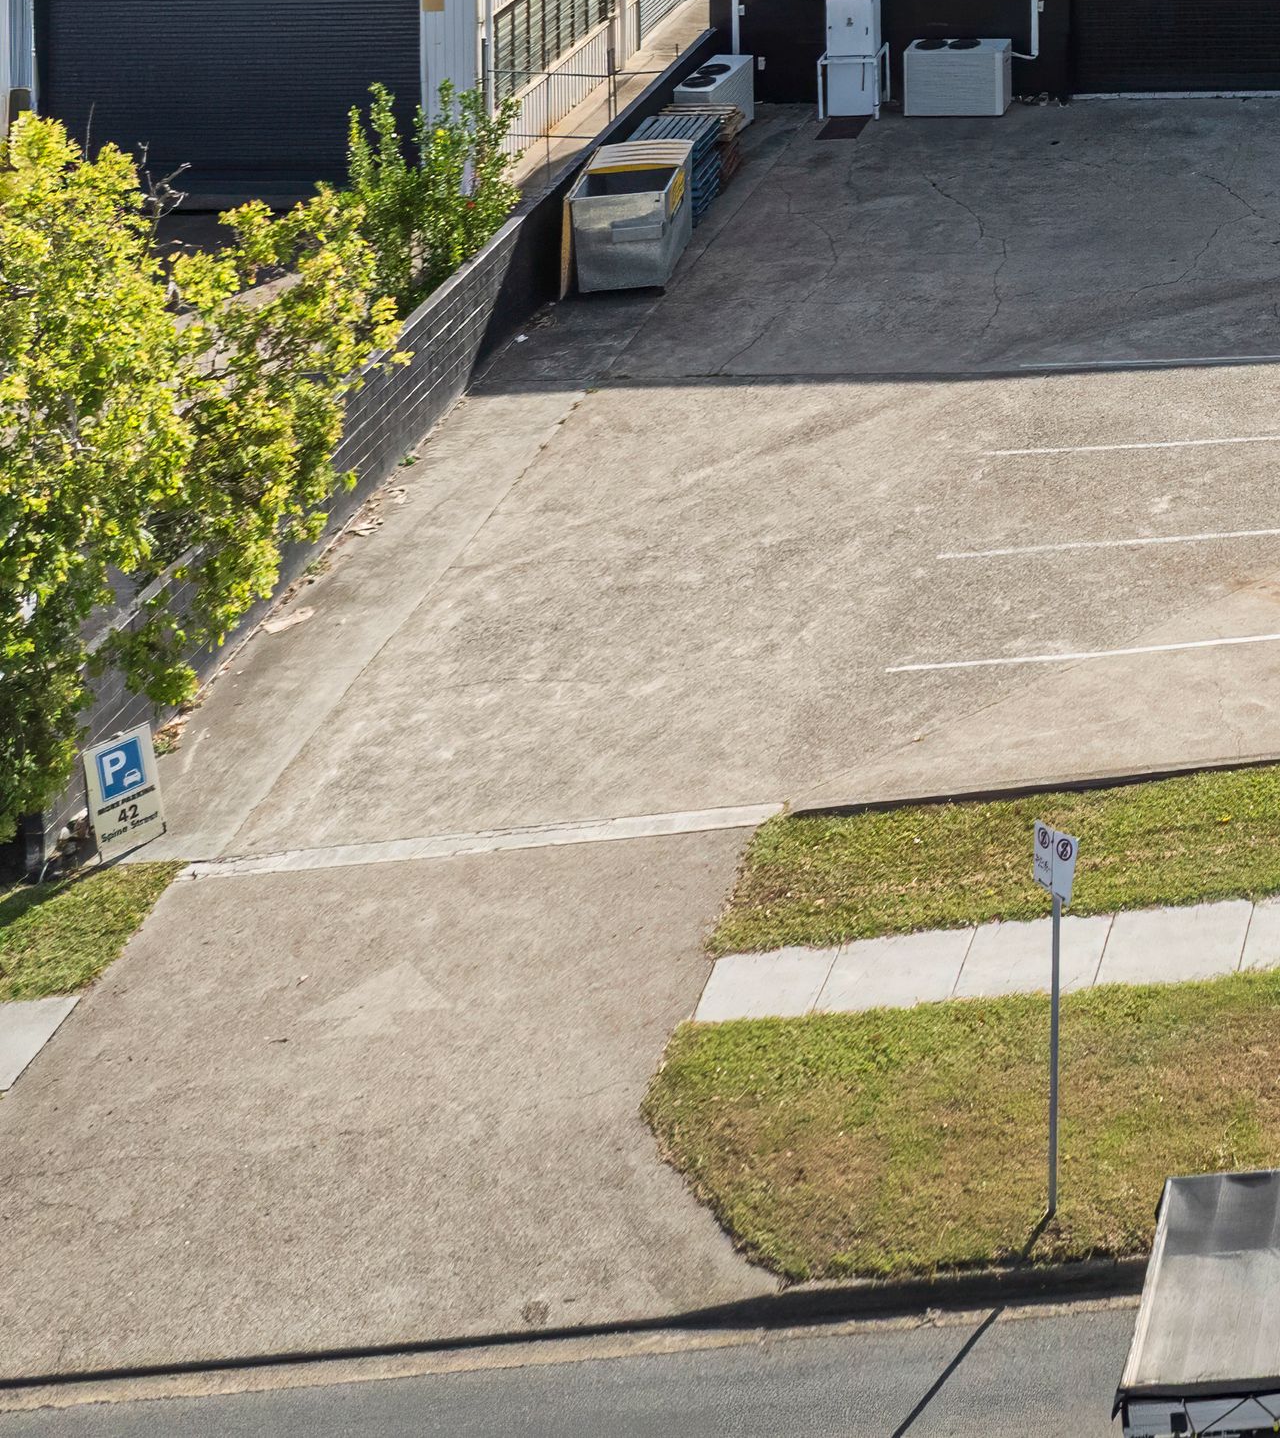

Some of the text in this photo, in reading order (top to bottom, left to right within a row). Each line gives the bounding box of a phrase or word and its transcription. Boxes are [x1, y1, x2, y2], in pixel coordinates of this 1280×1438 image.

[102, 750, 127, 787] P
[117, 804, 140, 822] 42
[101, 826, 128, 843] Spine
